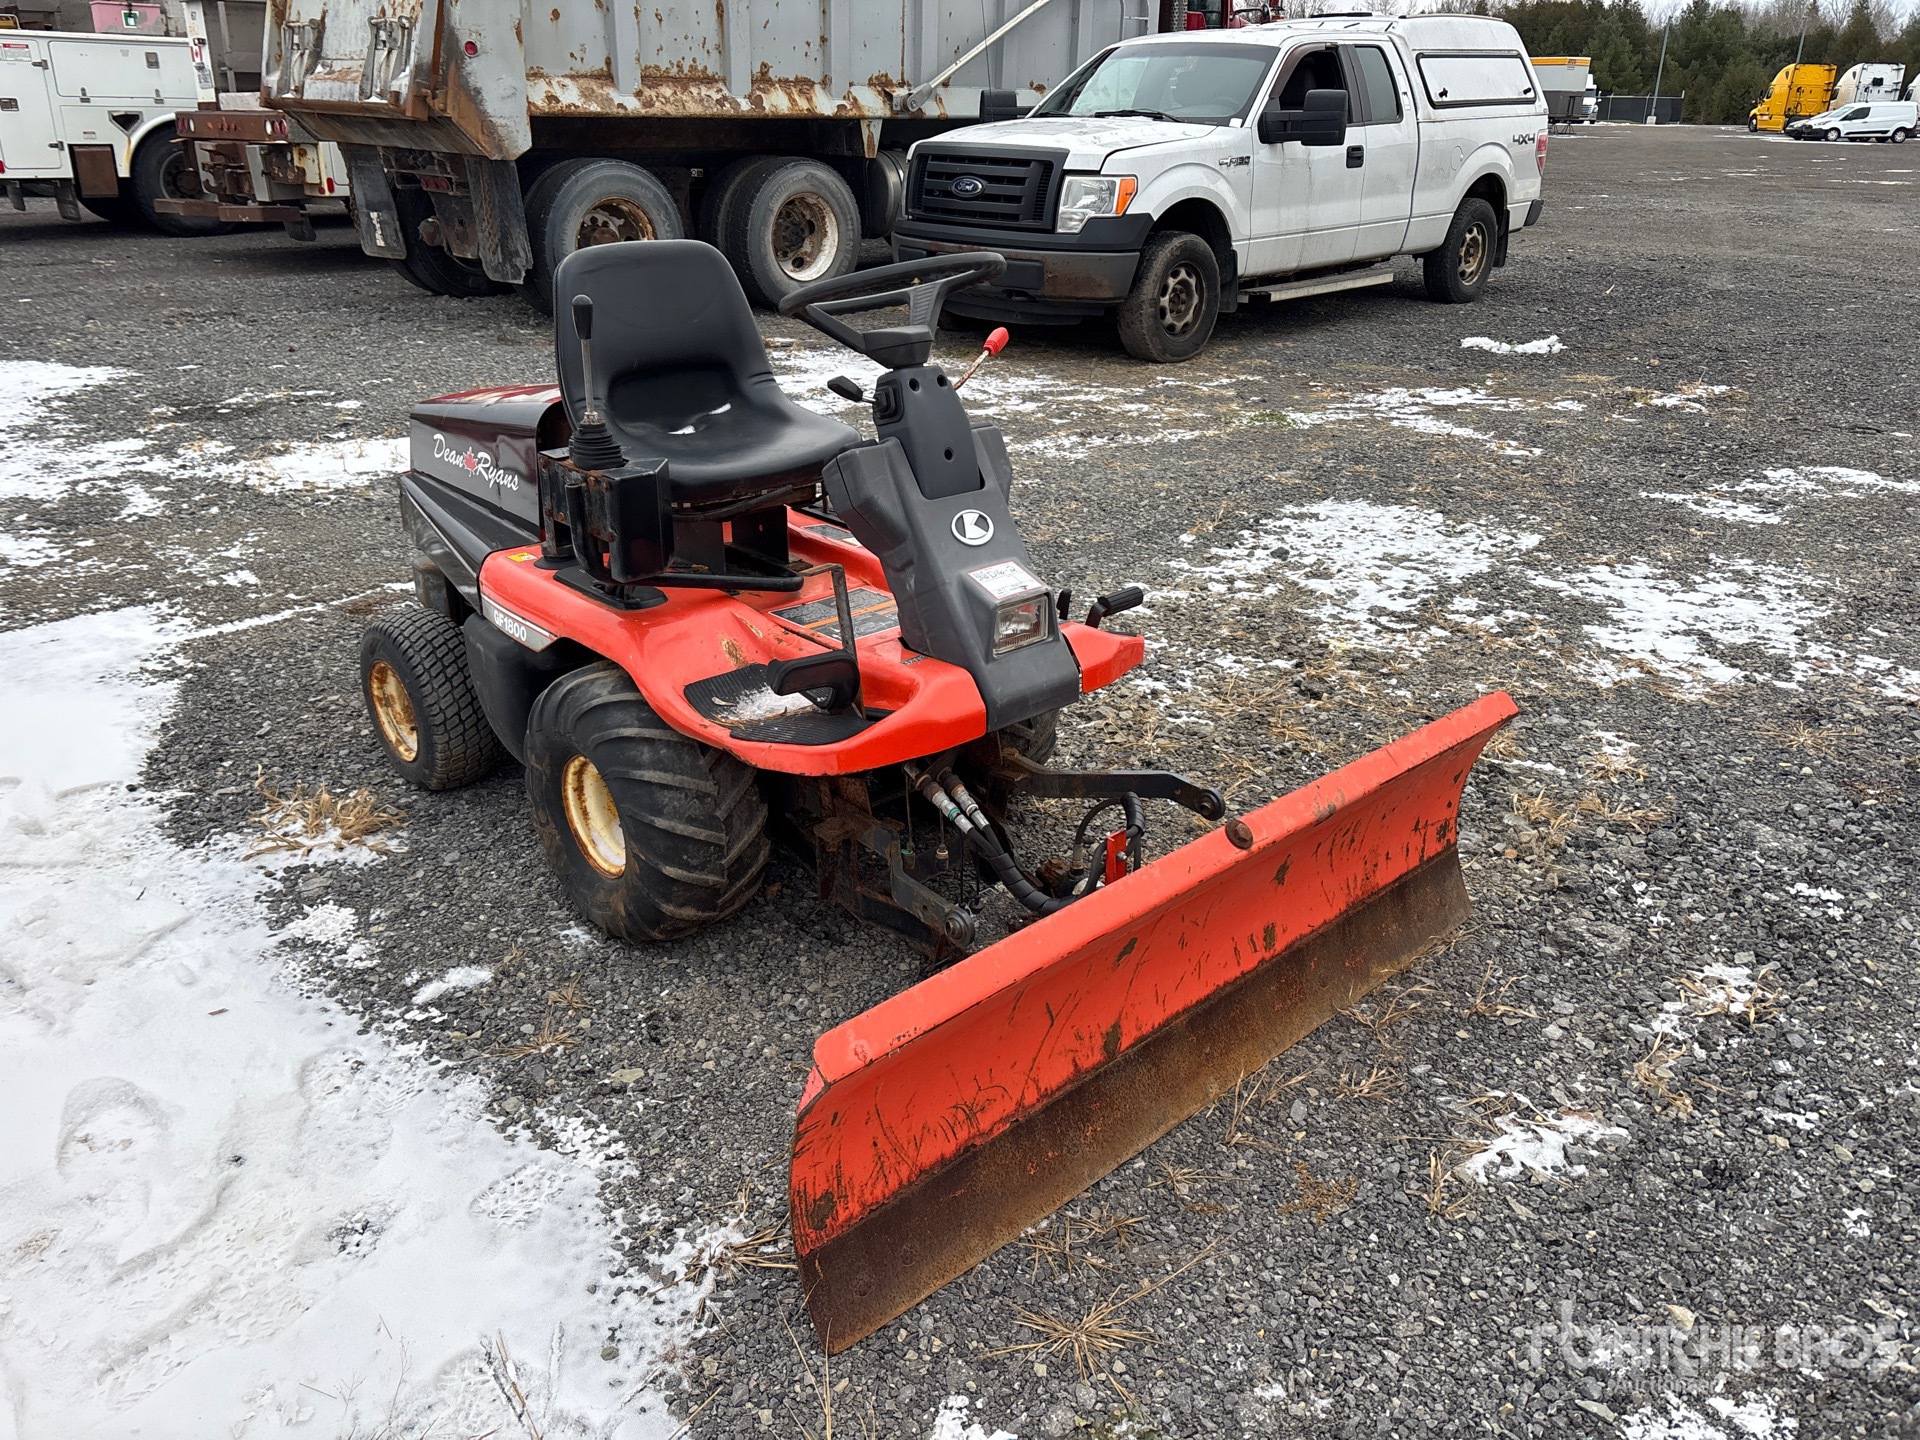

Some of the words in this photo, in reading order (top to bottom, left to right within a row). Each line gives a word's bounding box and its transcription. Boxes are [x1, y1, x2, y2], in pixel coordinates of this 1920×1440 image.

[1512, 133, 1536, 146] 4X4
[957, 179, 975, 191] Ford
[433, 433, 464, 468] Dean
[476, 452, 520, 491] Ryans
[493, 609, 528, 642] GF1800
